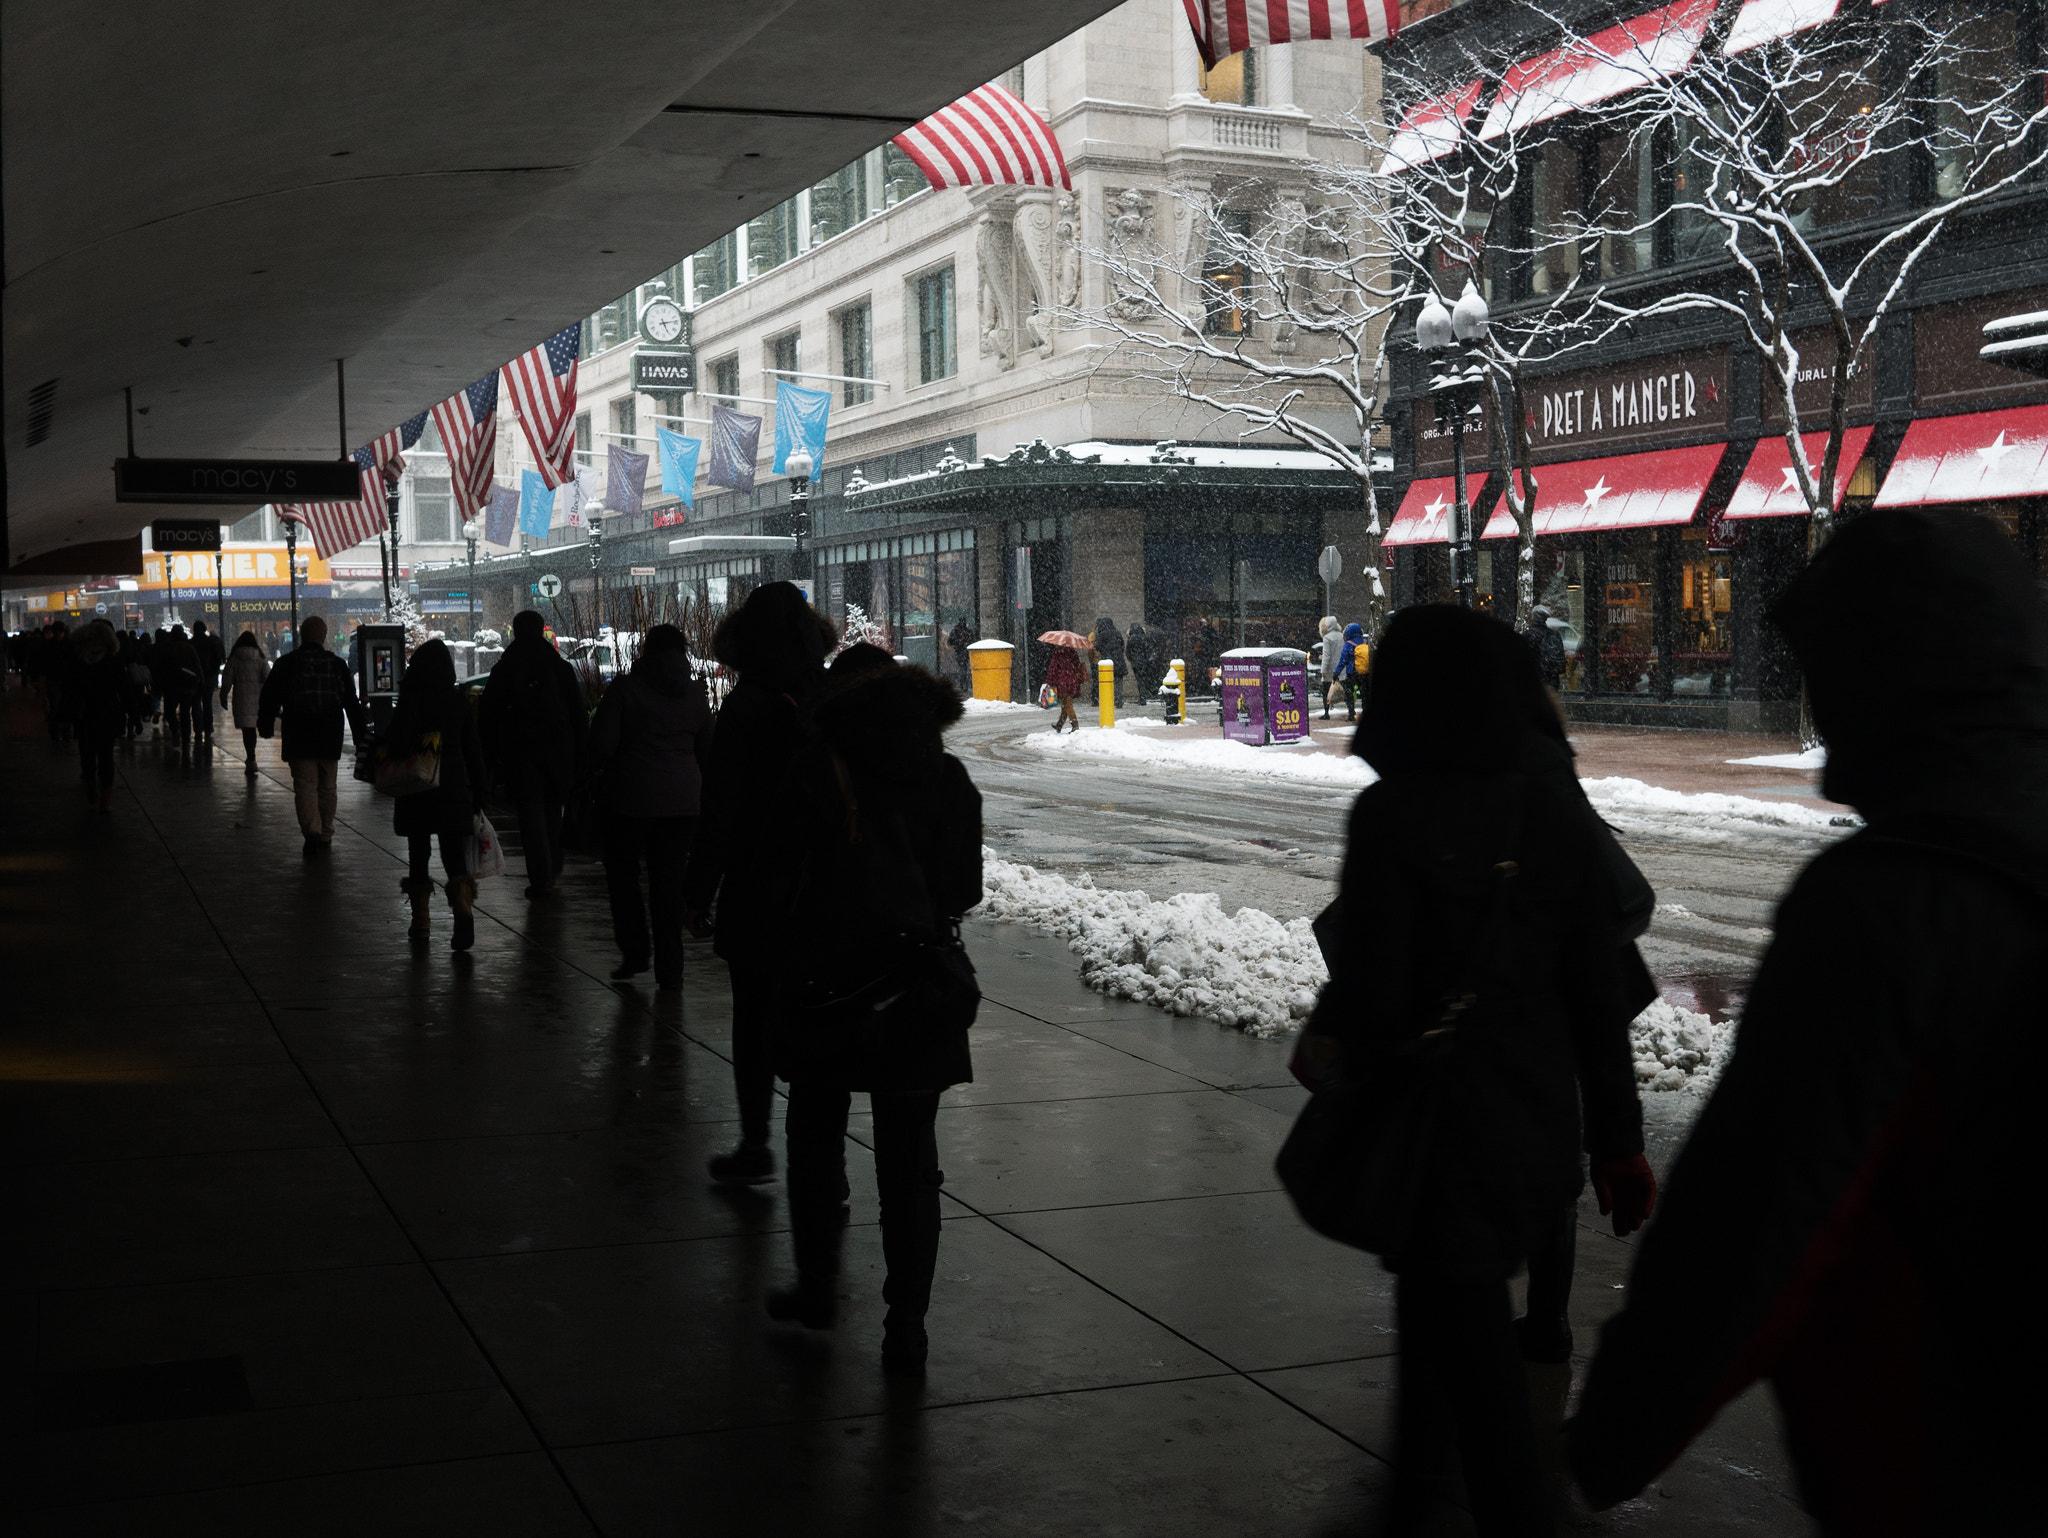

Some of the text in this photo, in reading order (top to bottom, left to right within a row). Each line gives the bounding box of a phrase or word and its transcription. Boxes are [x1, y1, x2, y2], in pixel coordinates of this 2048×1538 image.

[642, 366, 688, 378] HAVAS
[1797, 368, 1827, 383] URAL
[1543, 371, 1696, 438] PRET A MANGER
[1463, 421, 1483, 433] OFFE
[192, 469, 297, 493] macy's
[160, 528, 214, 544] macy's
[146, 561, 162, 582] THE
[160, 590, 169, 598] Bat
[178, 588, 197, 599] Body
[205, 601, 301, 613] Ba & Body Wors
[1608, 608, 1637, 624] ORGANIC
[1240, 678, 1260, 686] MONTH
[1276, 709, 1300, 725] $10
